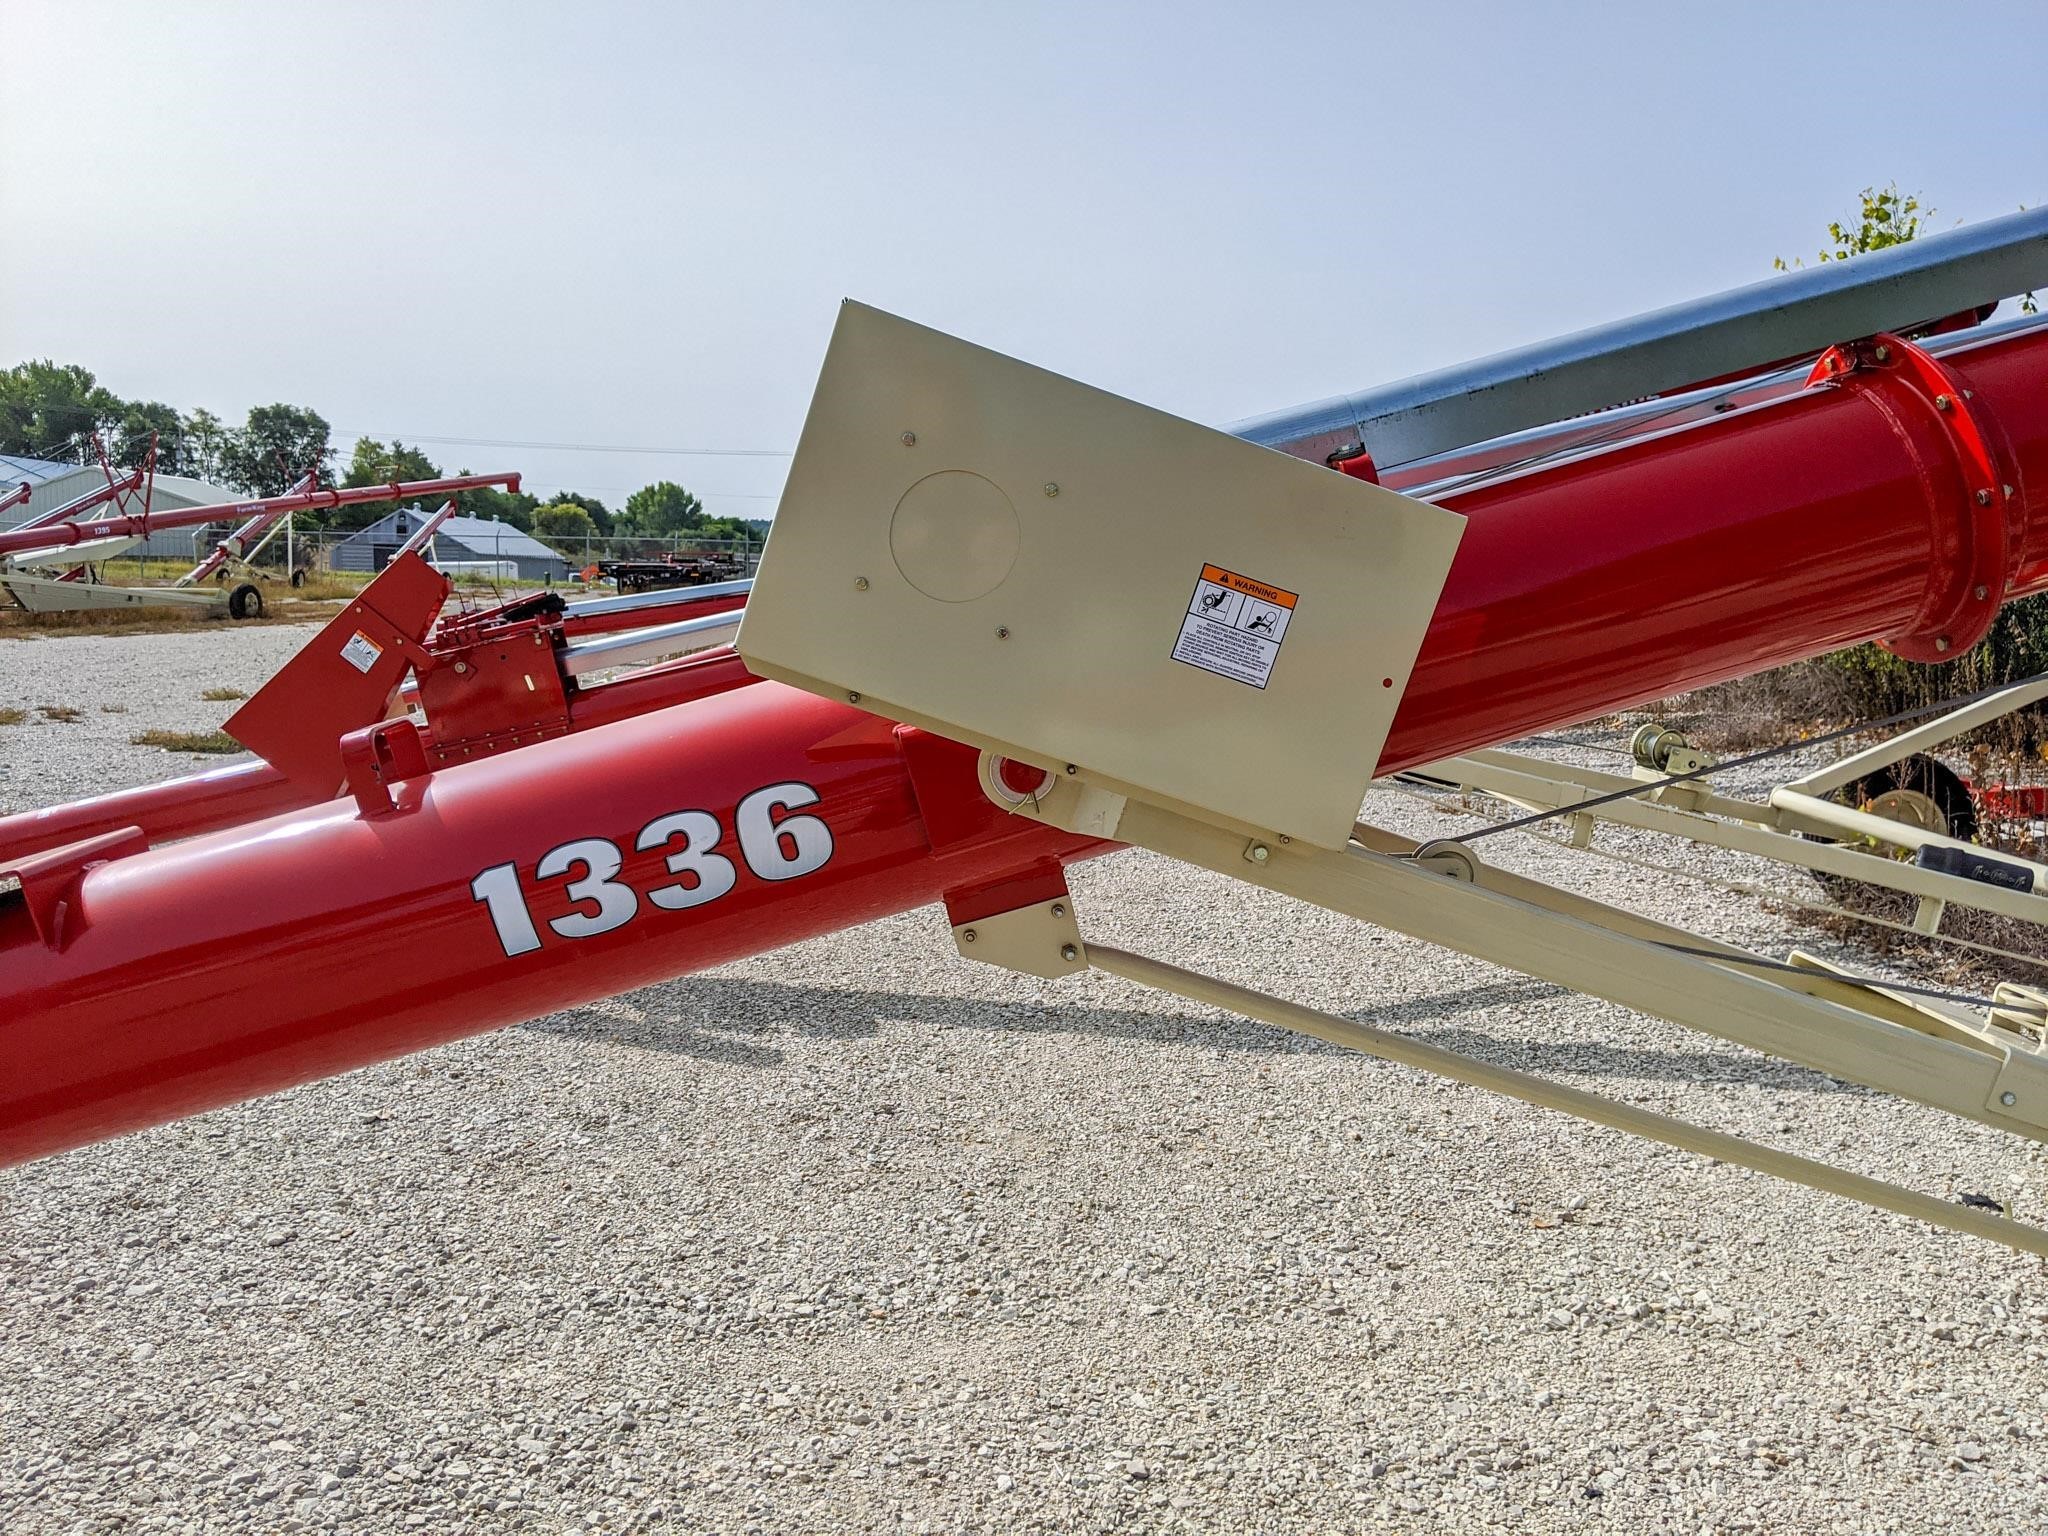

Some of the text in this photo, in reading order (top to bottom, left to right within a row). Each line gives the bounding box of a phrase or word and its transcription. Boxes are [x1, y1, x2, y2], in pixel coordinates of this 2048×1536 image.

[1233, 579, 1278, 600] WARNING
[1195, 629, 1211, 638] DEATH
[1211, 634, 1224, 642] FROM
[1224, 639, 1246, 650] ROTATING
[1203, 626, 1223, 636] PREVENT
[1223, 633, 1242, 643] SERIOUS
[1242, 640, 1258, 648] INJURY
[1206, 622, 1229, 633] ROTATING
[1240, 634, 1259, 644] HAZARD
[470, 781, 835, 957] 1336
